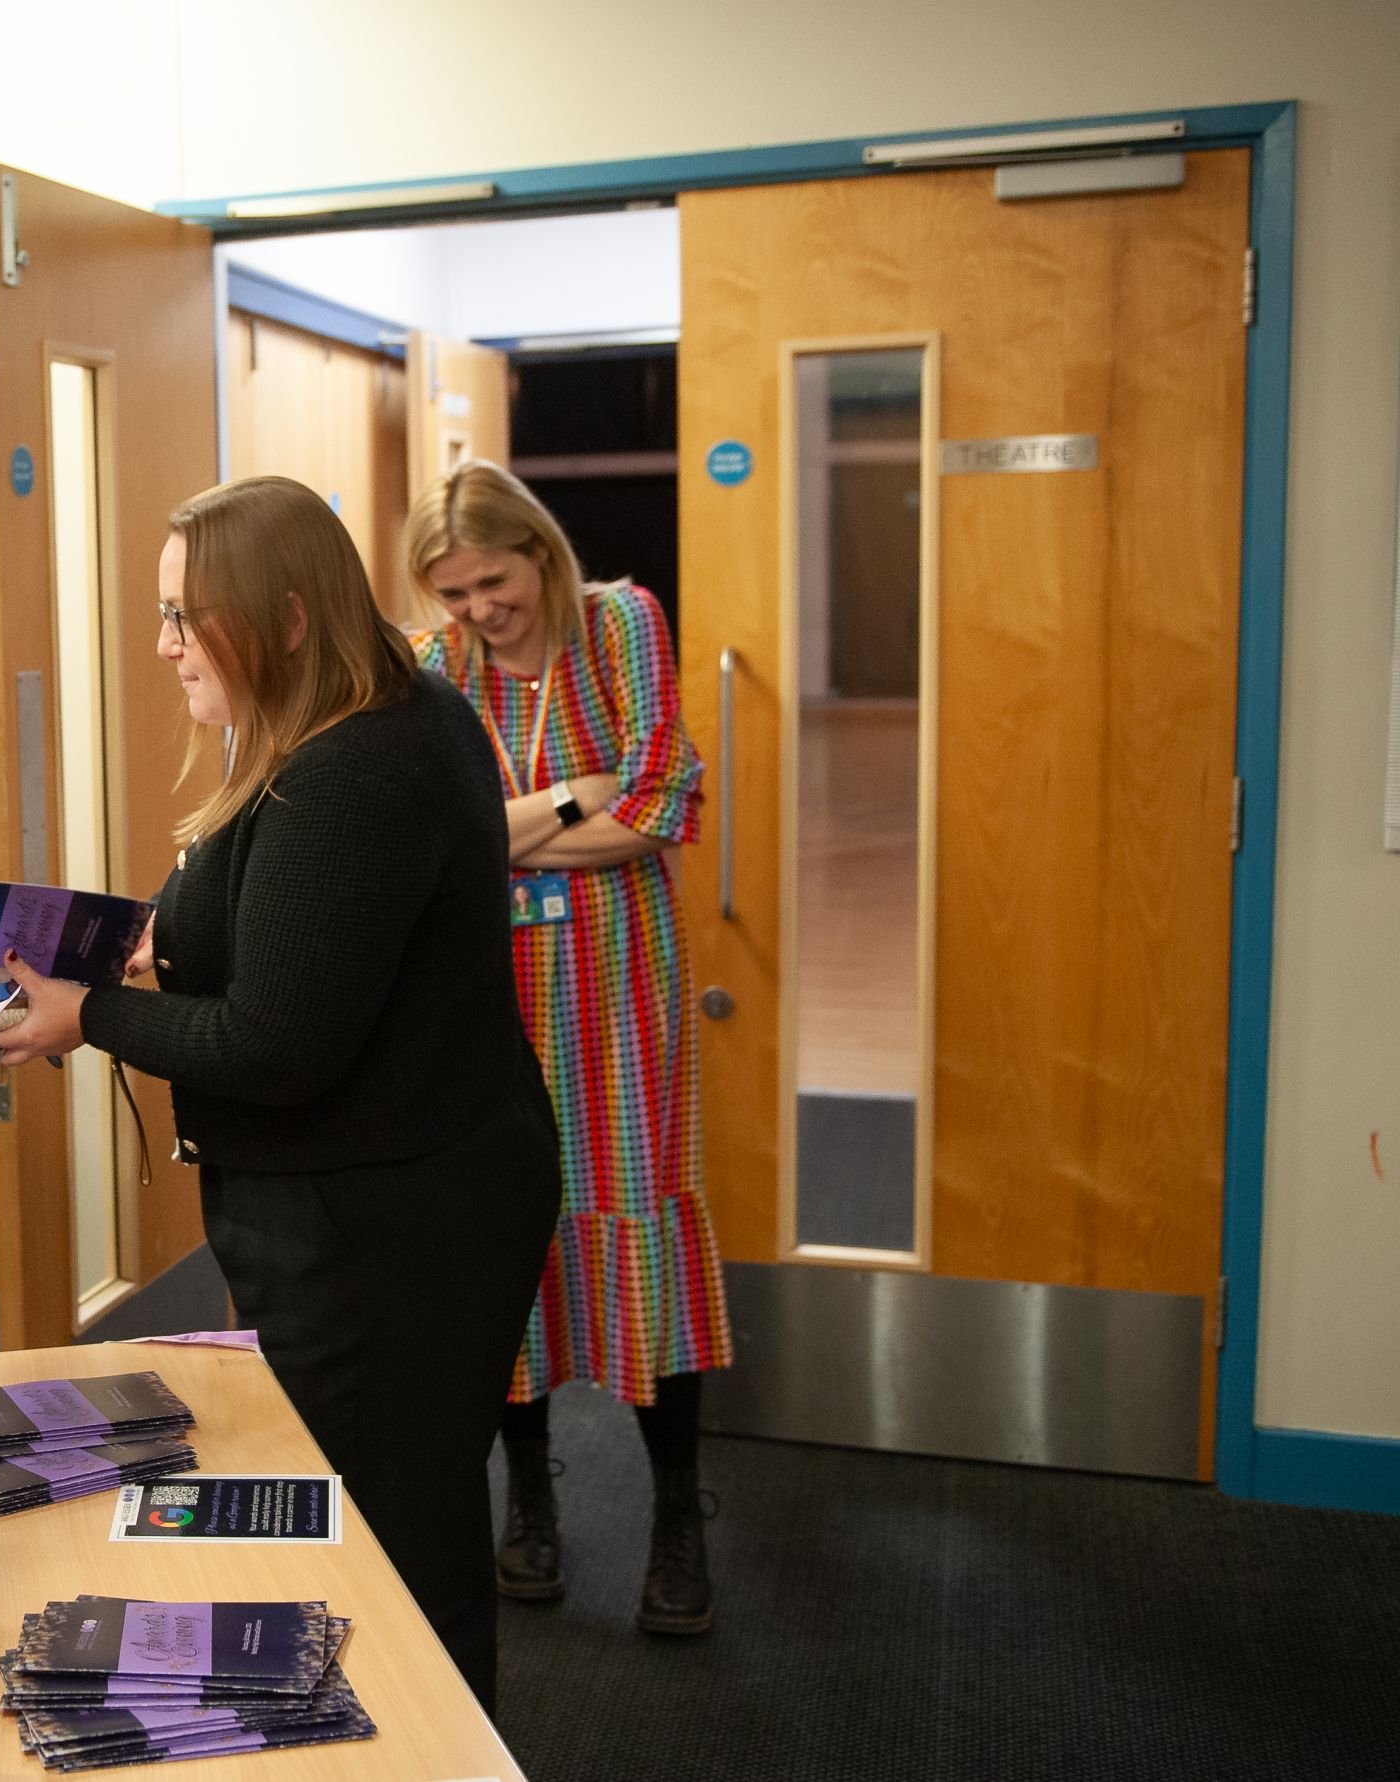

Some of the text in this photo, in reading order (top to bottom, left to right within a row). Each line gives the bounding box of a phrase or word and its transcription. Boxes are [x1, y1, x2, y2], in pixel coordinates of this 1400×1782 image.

[958, 441, 1073, 465] THEATRE
[129, 1613, 171, 1661] Awards
[170, 1614, 204, 1657] Evening
